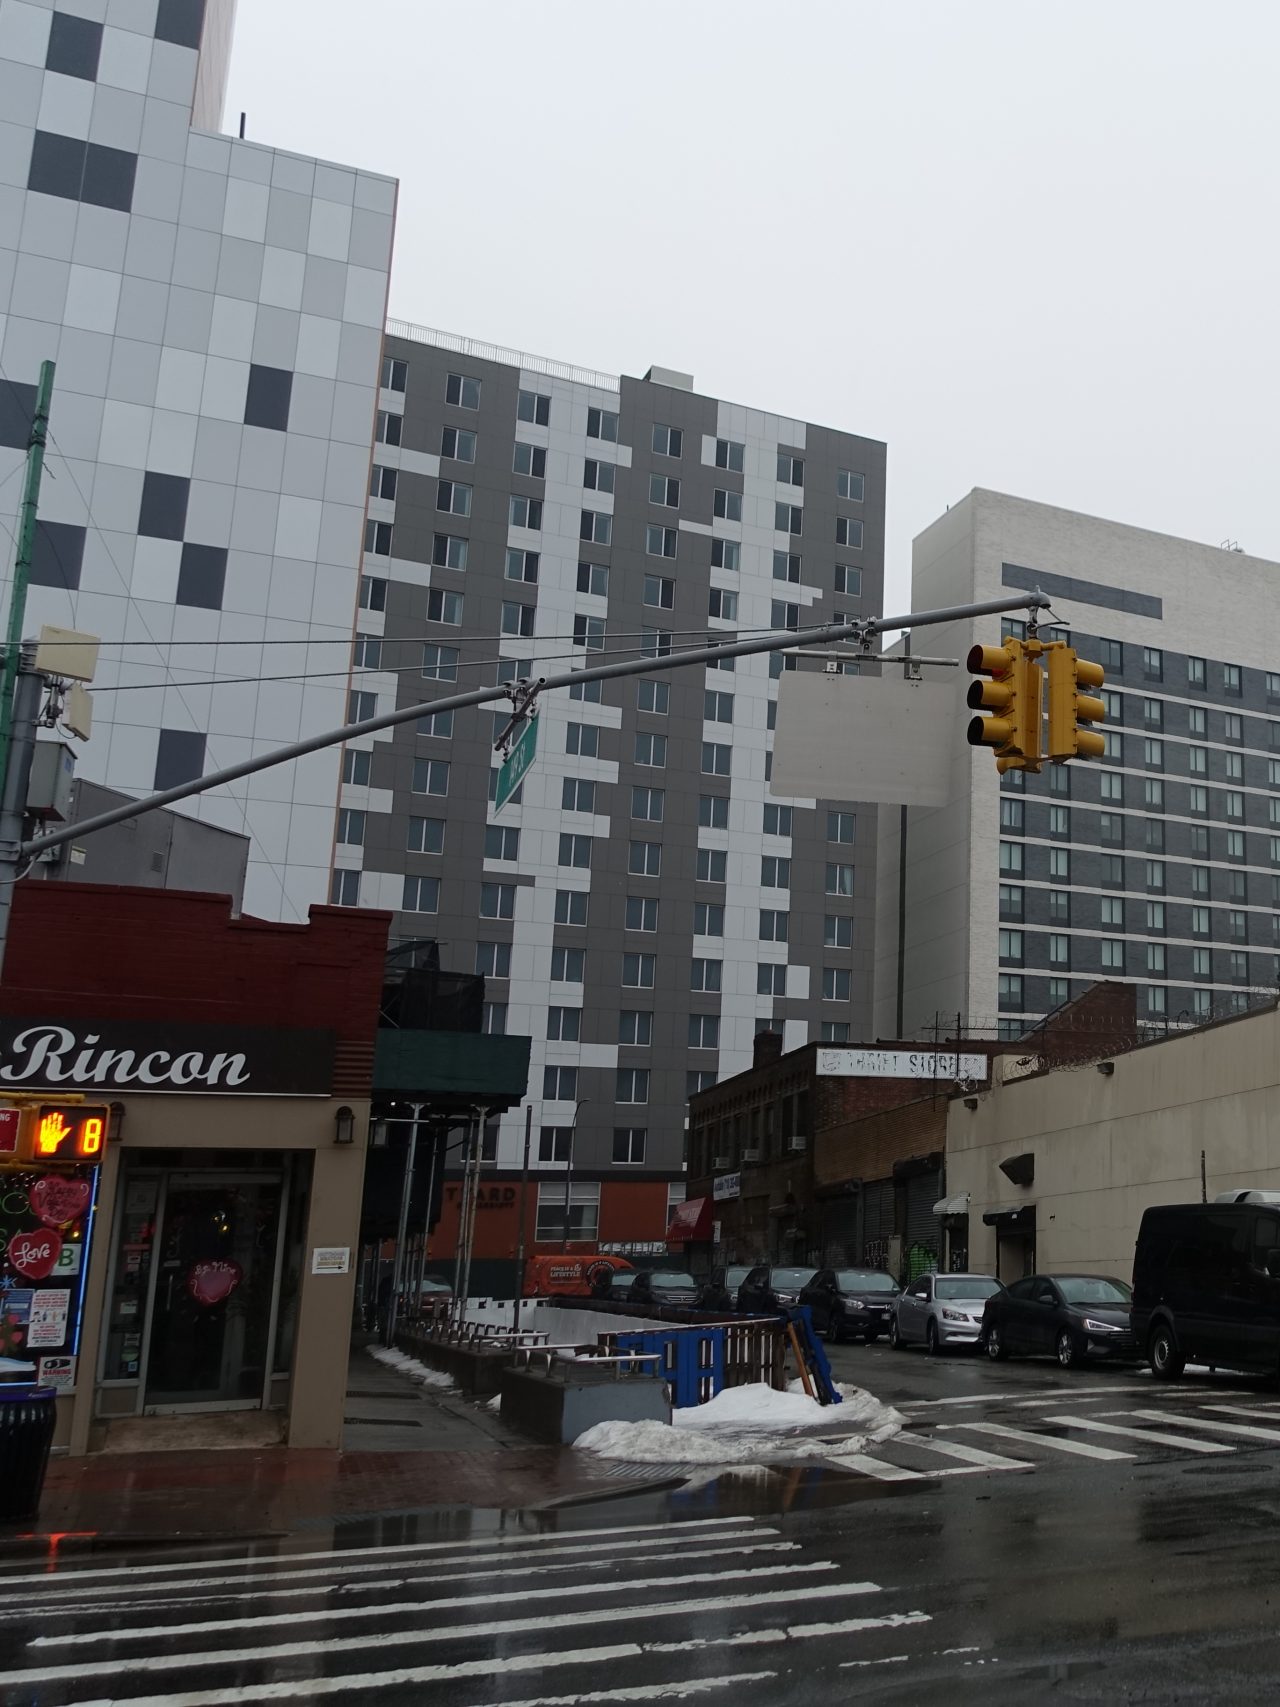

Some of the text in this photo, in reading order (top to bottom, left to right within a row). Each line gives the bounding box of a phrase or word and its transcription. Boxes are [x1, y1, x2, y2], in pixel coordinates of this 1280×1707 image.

[0, 1026, 250, 1086] Rincon
[83, 1118, 102, 1153] 8
[14, 1242, 50, 1268] Love
[58, 1248, 74, 1267] B
